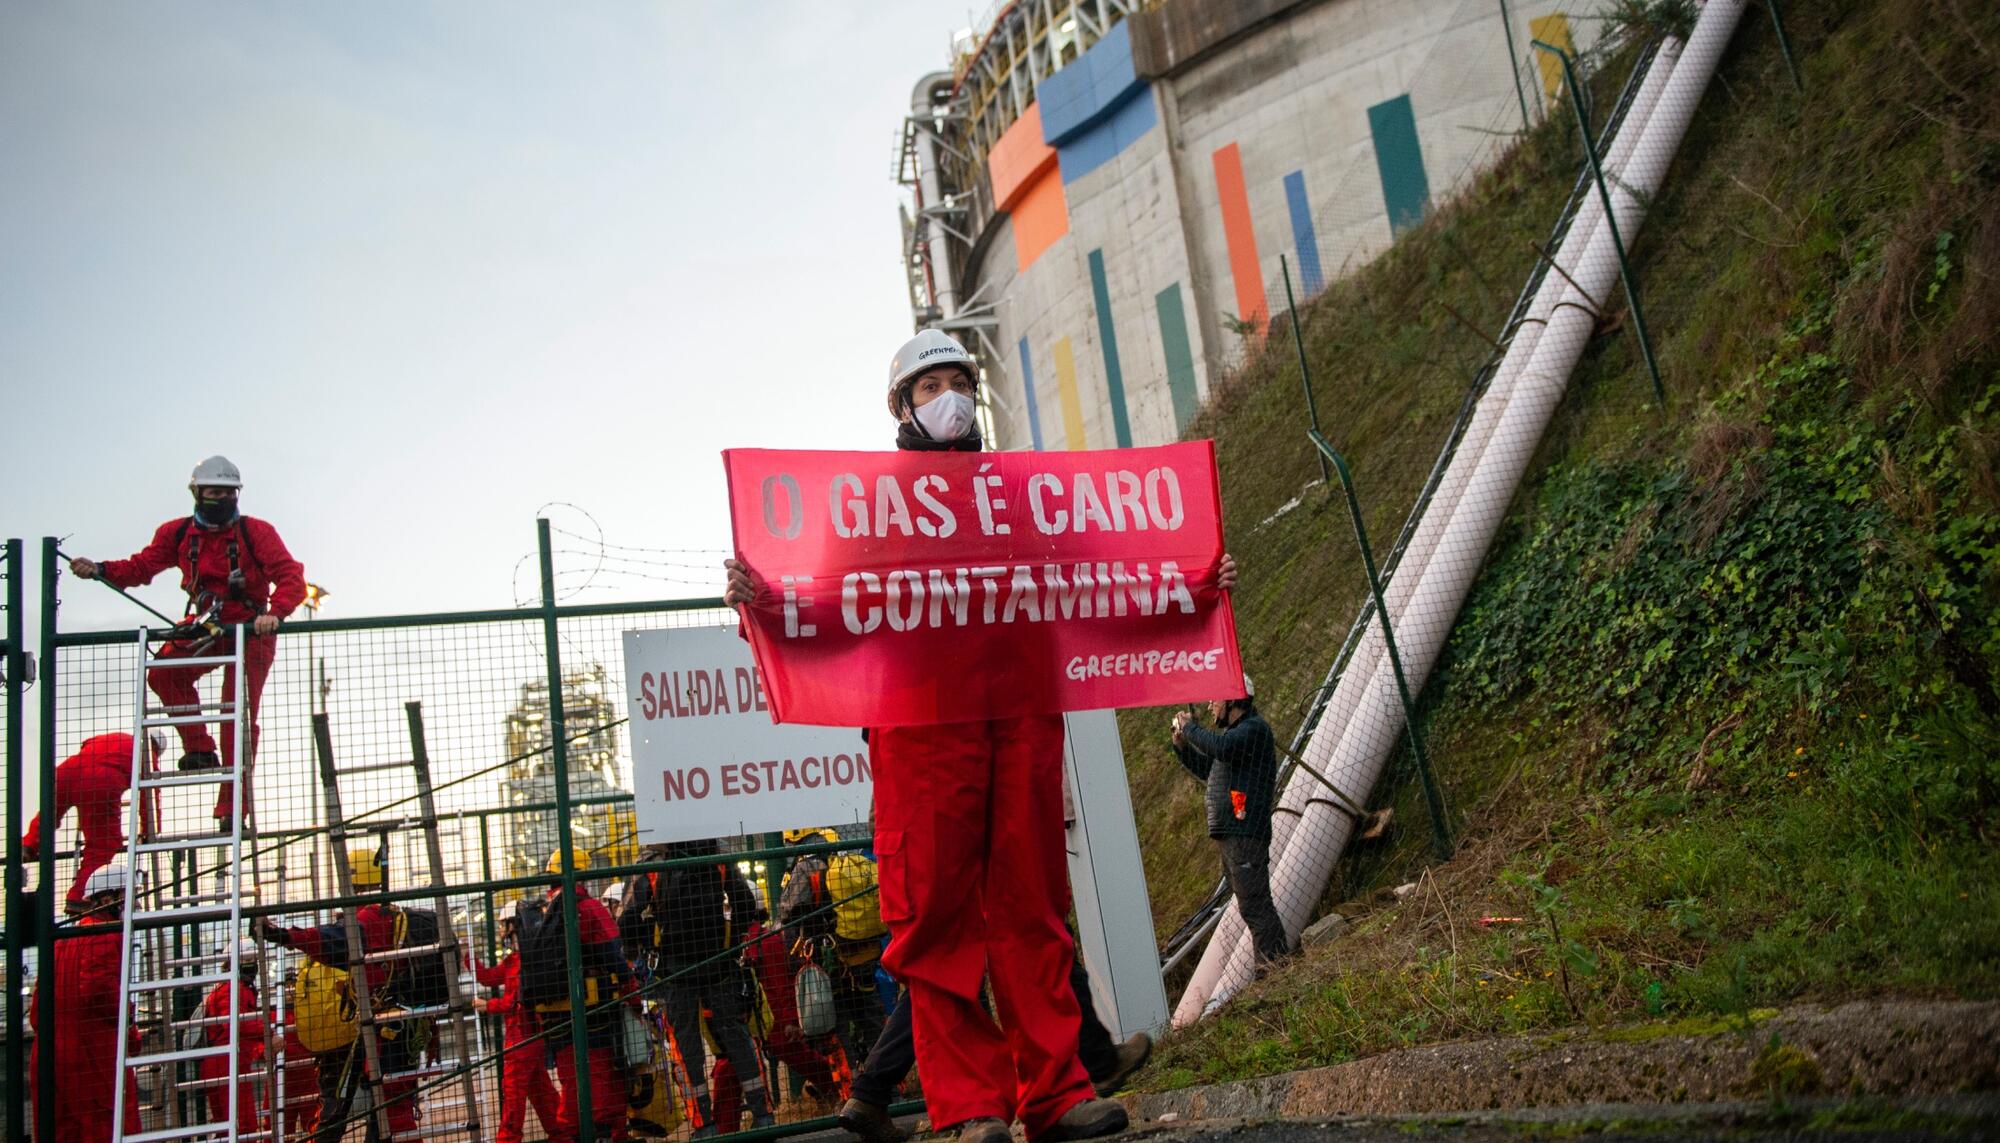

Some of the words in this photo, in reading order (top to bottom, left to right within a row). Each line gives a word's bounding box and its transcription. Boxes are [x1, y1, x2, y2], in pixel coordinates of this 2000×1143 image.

[918, 346, 964, 360] GREENPE
[763, 473, 801, 539] O
[829, 473, 957, 538] GAS
[973, 463, 1011, 536] É
[1028, 467, 1184, 534] CARO
[783, 575, 817, 638] E
[841, 561, 1196, 635] CONTAMINA
[1066, 647, 1224, 681] GREENPEACE
[641, 668, 730, 720] SALIDA
[663, 767, 710, 801] NO
